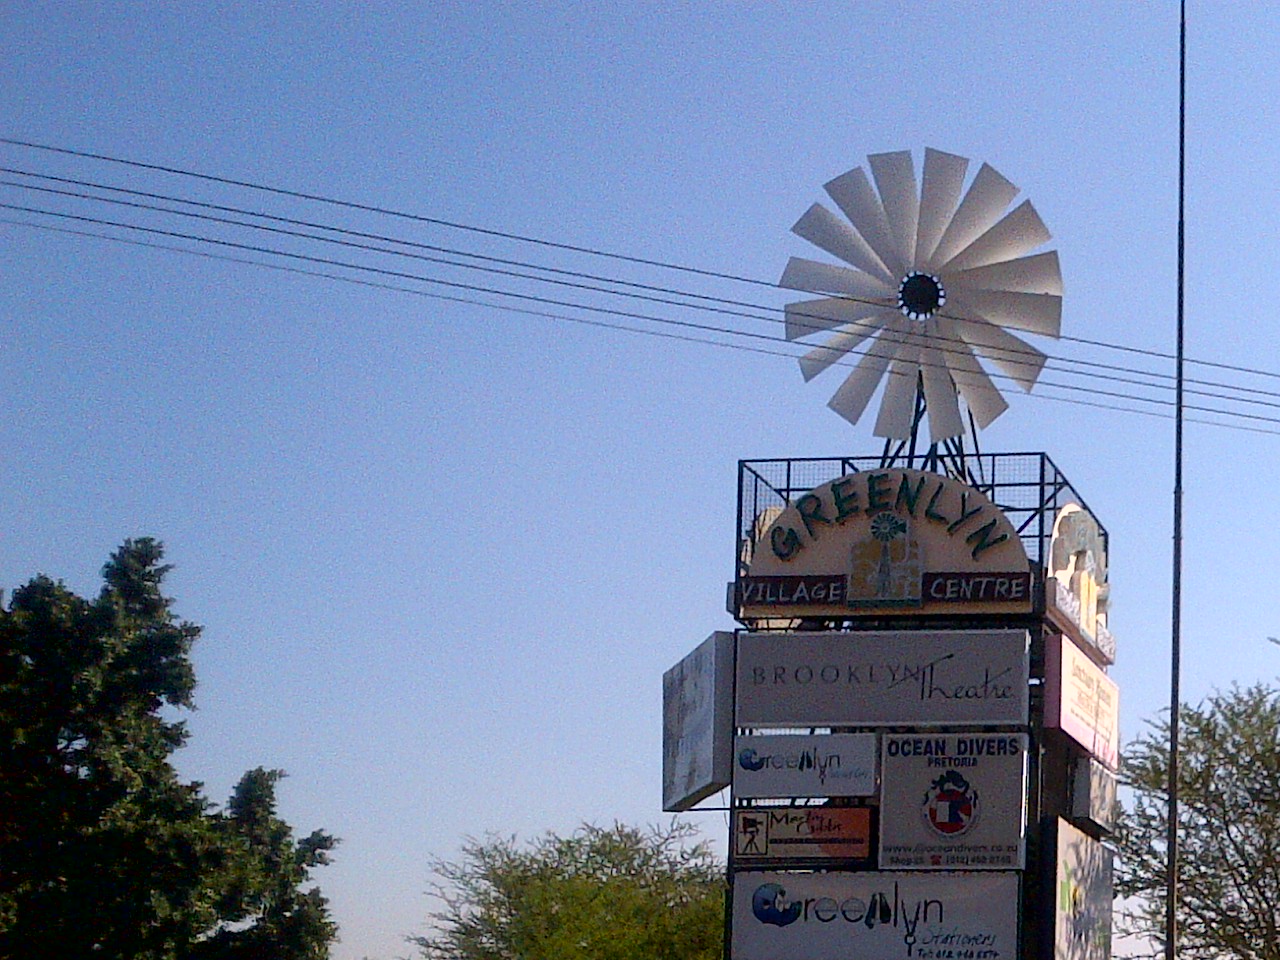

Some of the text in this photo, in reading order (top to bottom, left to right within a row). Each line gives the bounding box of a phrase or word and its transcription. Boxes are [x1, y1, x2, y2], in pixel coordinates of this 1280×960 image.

[769, 472, 1011, 563] GREENLYN
[741, 577, 1025, 602] VILLAGE CENTRE
[752, 663, 920, 687] BROOKLYN
[887, 738, 1019, 757] OCEAN DIVERS
[928, 757, 978, 768] PRETORIA
[752, 880, 944, 957] Greenlyn
